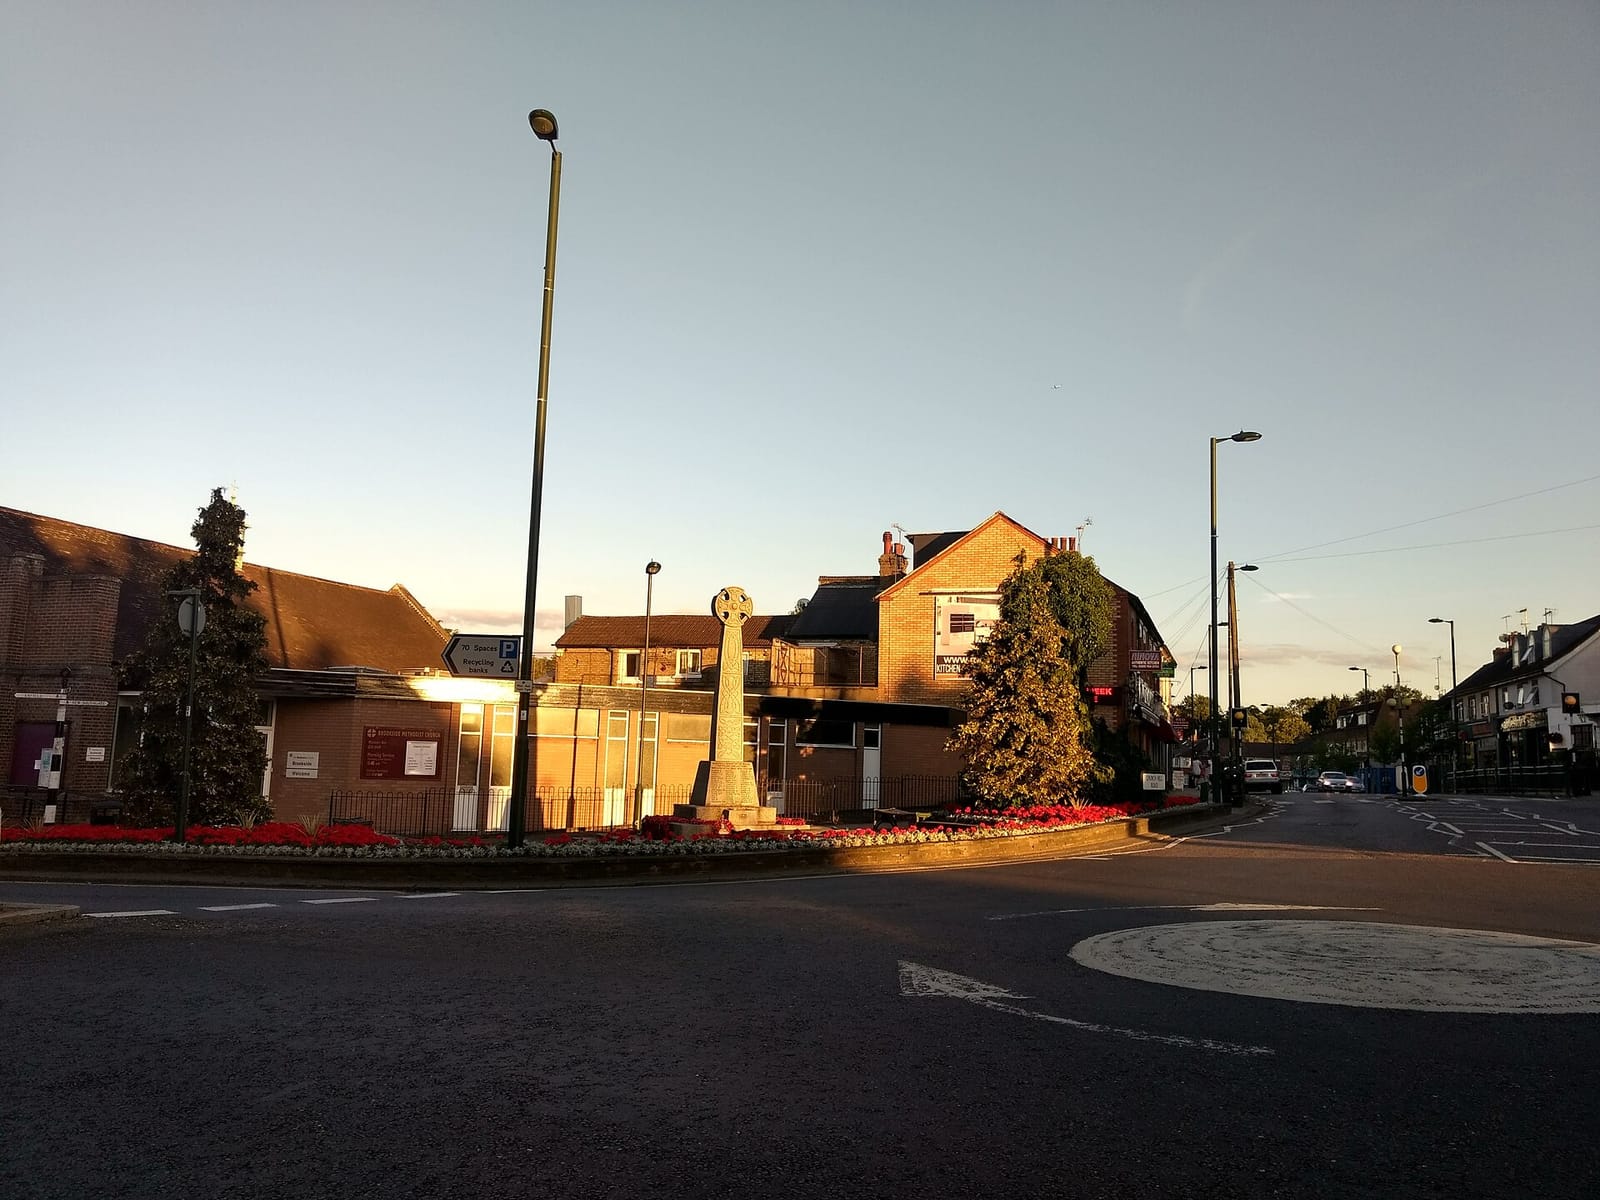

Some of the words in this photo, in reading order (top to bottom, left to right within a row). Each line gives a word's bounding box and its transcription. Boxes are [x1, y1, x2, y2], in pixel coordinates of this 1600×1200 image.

[474, 644, 498, 652] Spaces
[502, 641, 515, 658] P
[463, 658, 495, 667] Recycling
